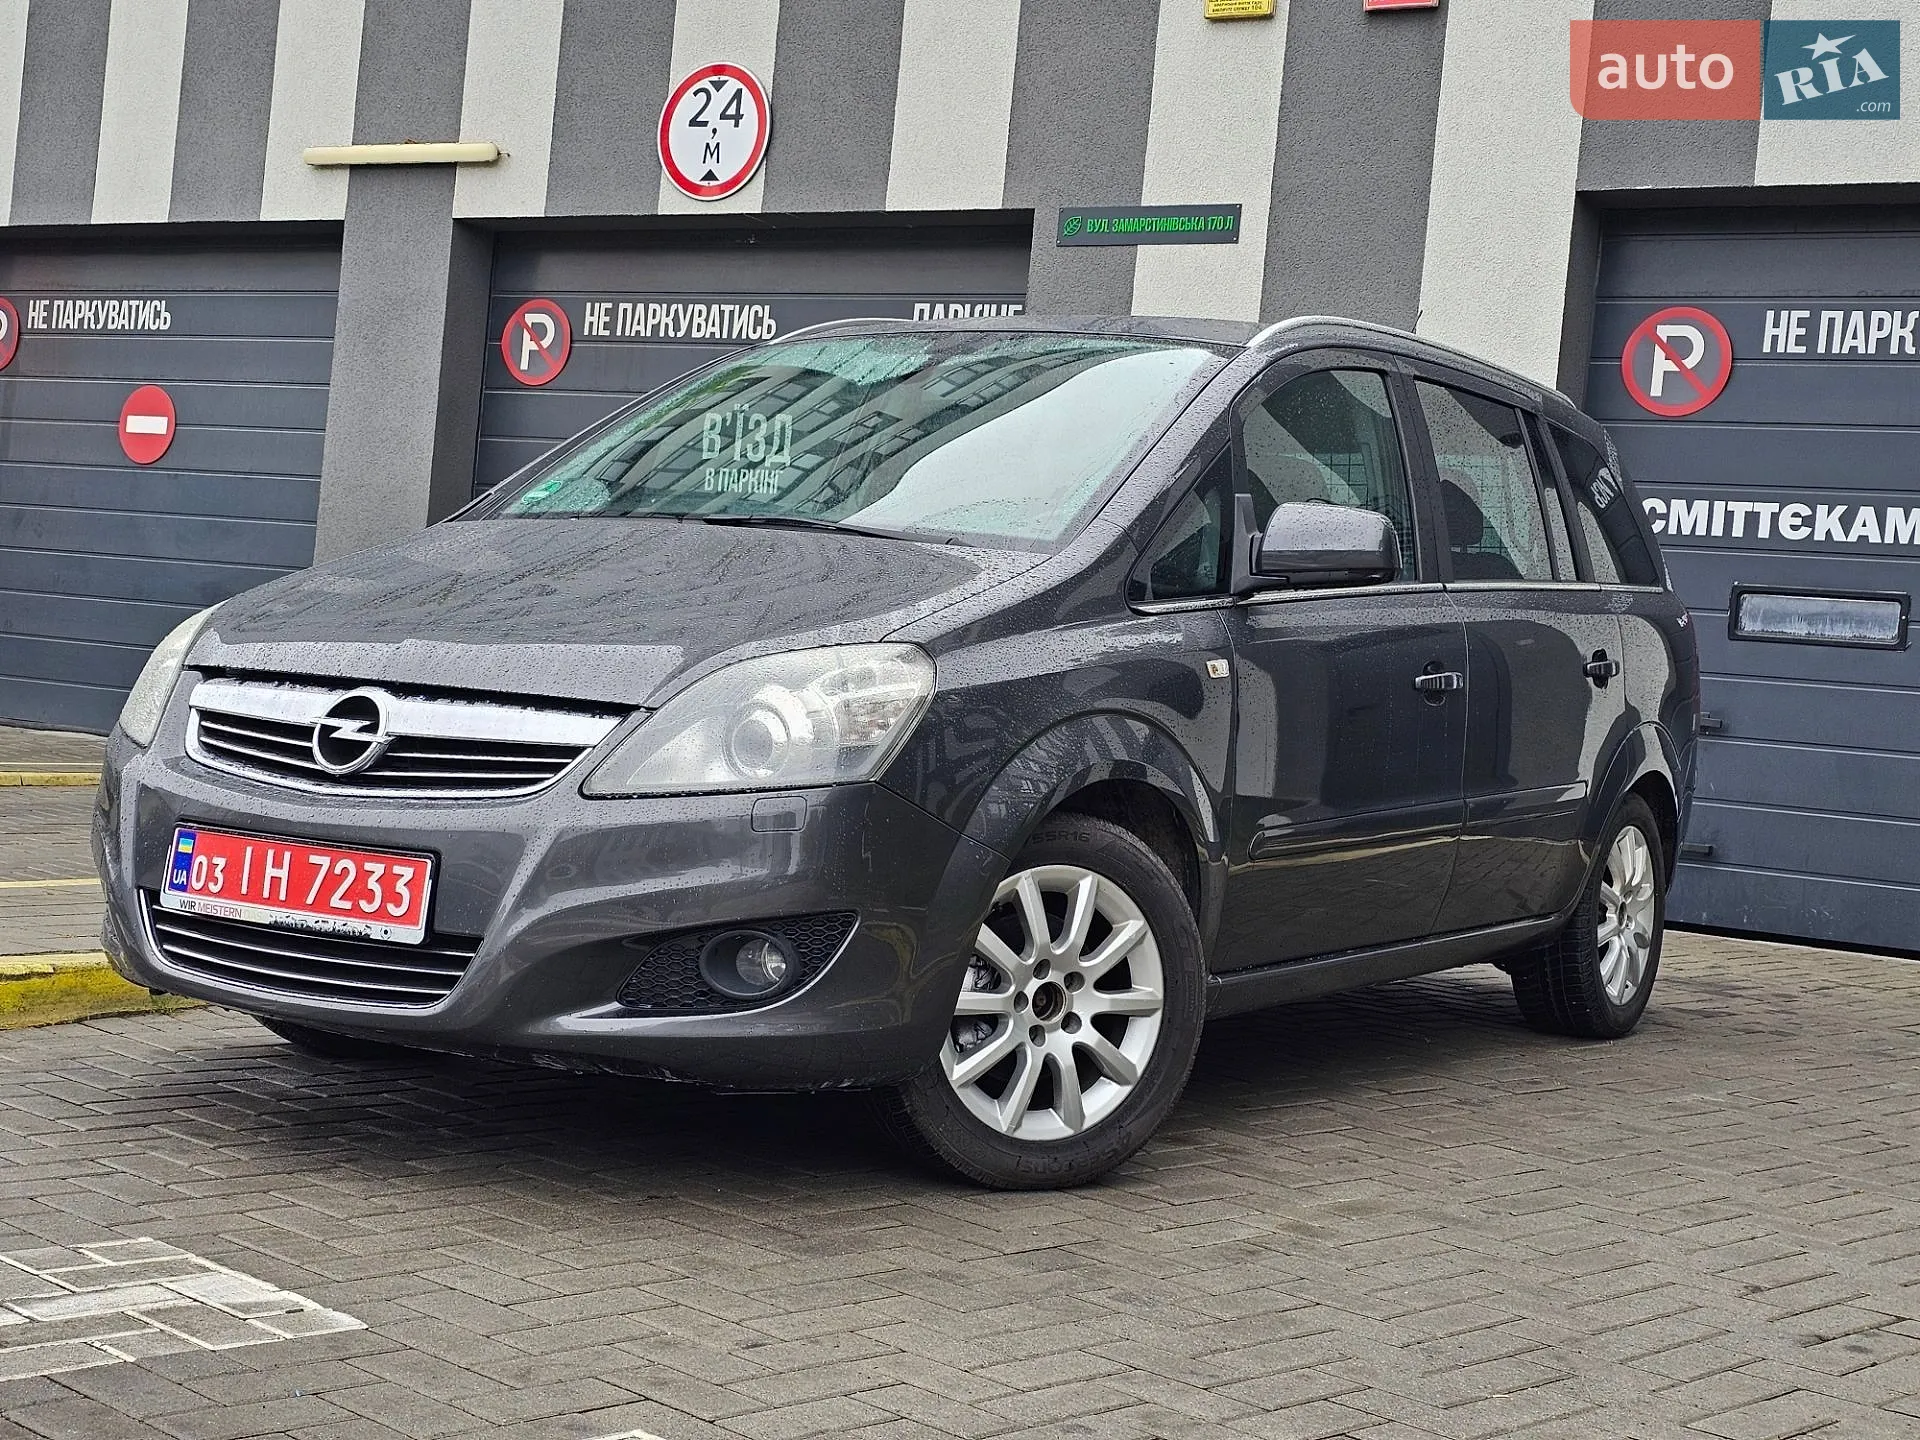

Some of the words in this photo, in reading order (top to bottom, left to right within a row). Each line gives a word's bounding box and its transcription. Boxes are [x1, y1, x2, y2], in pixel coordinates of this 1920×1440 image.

[702, 142, 720, 164] М
[1087, 218, 1110, 233] ВУЛ.
[1112, 216, 1205, 233] ЗАМАРСТИНІВСЬКА
[1207, 216, 1224, 230] 170
[1224, 216, 1234, 230] Л
[28, 299, 49, 329] НЕ
[51, 299, 171, 330] ПАРКУВАТИСЬ
[583, 302, 613, 336] НЕ
[616, 303, 777, 340] ПАРКУВАТИСЬ
[1762, 310, 1811, 354] НЕ
[704, 468, 715, 491] В
[717, 468, 784, 494] ПАРКІНГ
[173, 869, 187, 885] UA
[191, 855, 227, 893] 03
[305, 854, 415, 917] 7233
[179, 899, 197, 911] WIR
[197, 902, 242, 919] MEISTERN
